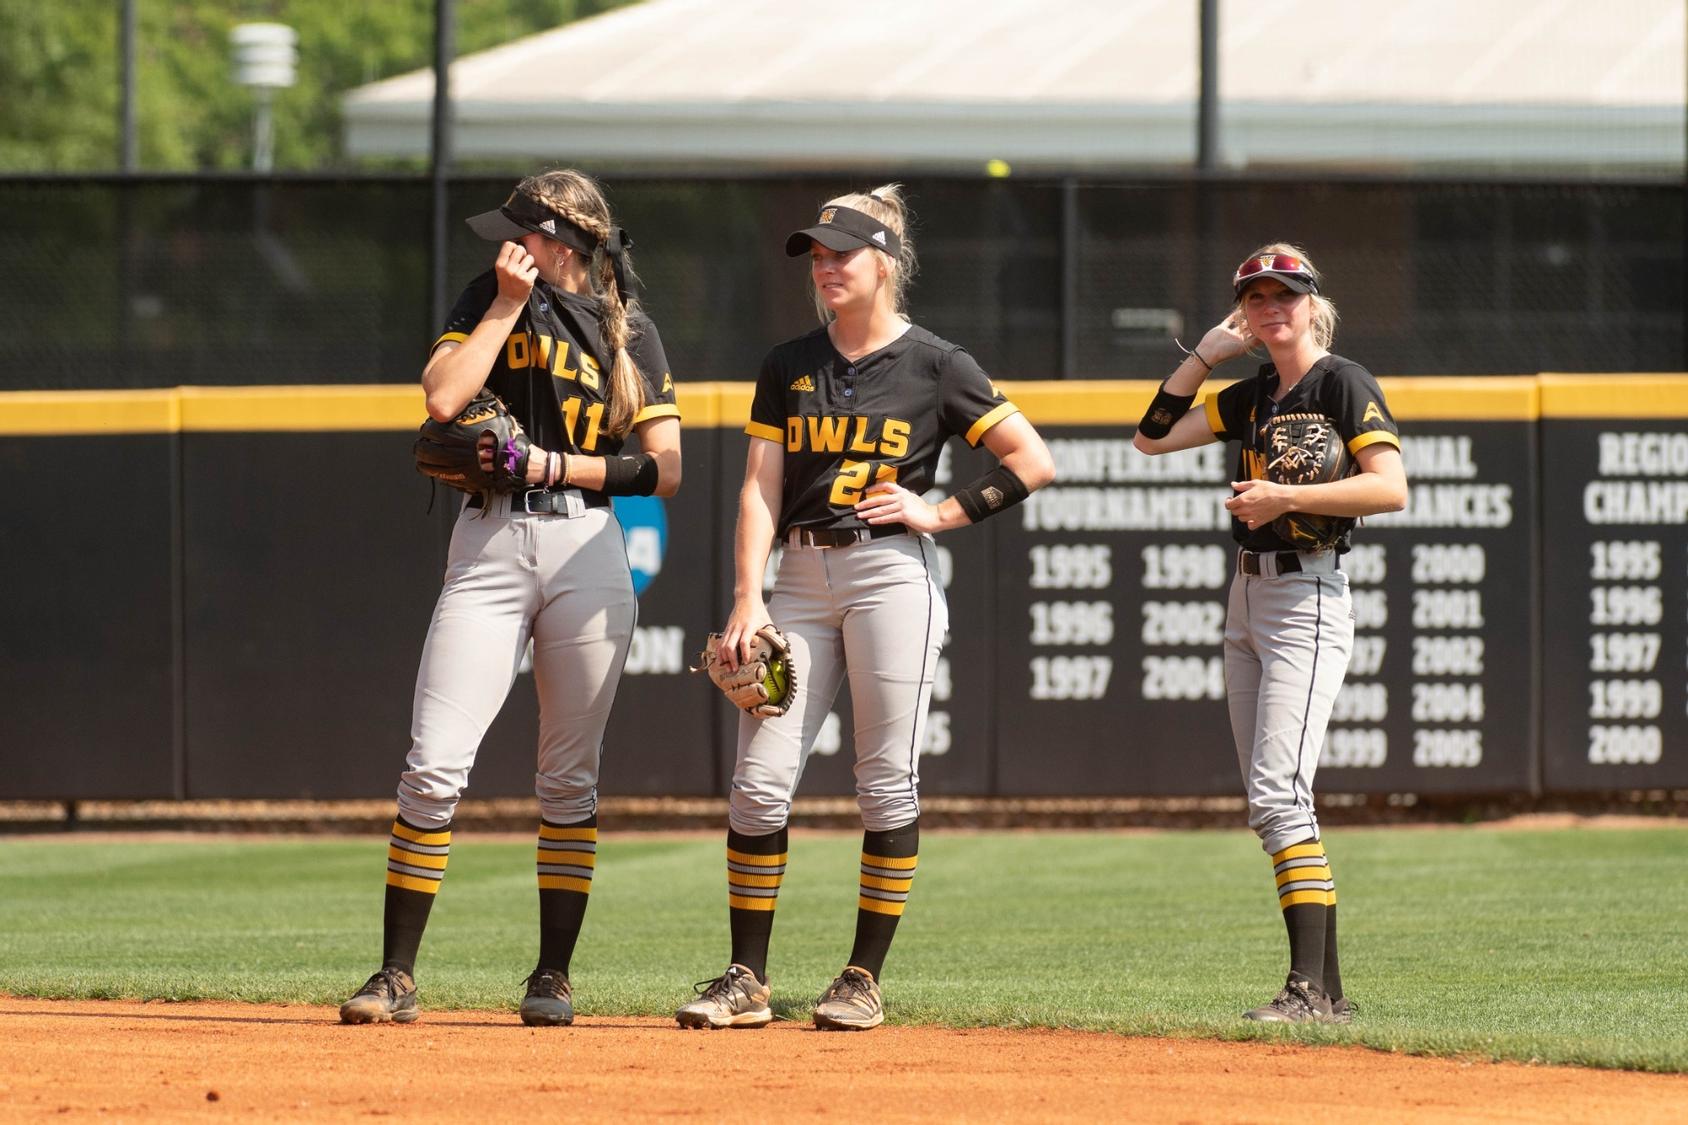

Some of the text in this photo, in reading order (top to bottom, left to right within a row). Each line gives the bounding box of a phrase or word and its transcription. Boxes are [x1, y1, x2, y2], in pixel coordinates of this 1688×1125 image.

[507, 332, 600, 390] OWLS
[561, 396, 605, 452] 11
[787, 415, 912, 458] OWLS
[1045, 439, 1226, 482] ONFERENCE
[1599, 433, 1688, 475] REGIO
[1022, 485, 1234, 531] TOURNAMENT
[1031, 545, 1226, 588] 1995 1998
[1341, 544, 1486, 583] 95 2000
[1590, 541, 1662, 579] 1995
[1031, 601, 1225, 645] 1996 2002
[1351, 590, 1485, 628] 96 2001
[1590, 587, 1663, 625] 1996
[1348, 636, 1485, 675] 97 2002
[1590, 633, 1662, 671] 1997
[1031, 656, 1225, 699] 1997 2004
[1330, 683, 1485, 721] 998 2004
[1590, 679, 1663, 718] 1999
[1412, 729, 1483, 767] 2005
[1588, 725, 1663, 764] 2000
